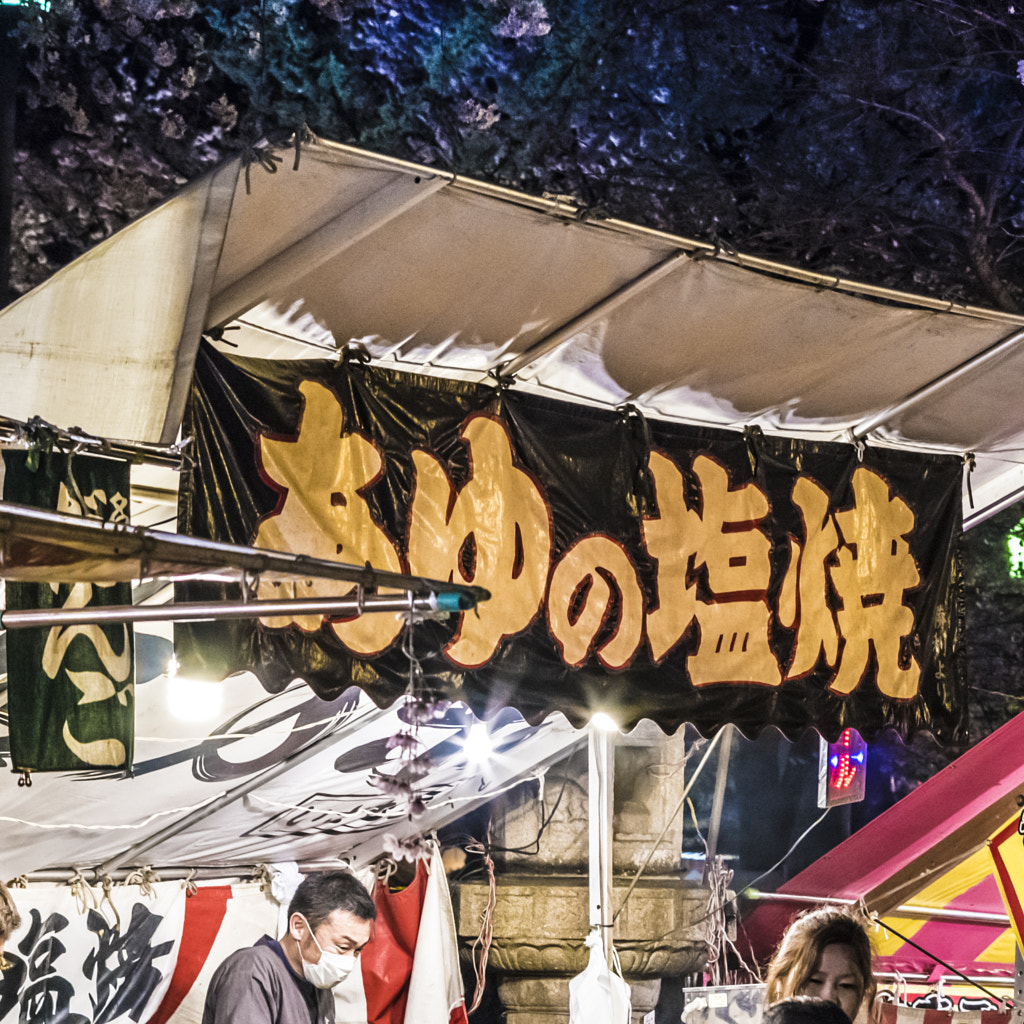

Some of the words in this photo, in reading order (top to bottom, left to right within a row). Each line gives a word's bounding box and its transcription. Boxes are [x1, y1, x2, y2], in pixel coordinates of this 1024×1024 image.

[253, 378, 923, 700] あゆの塩焼
